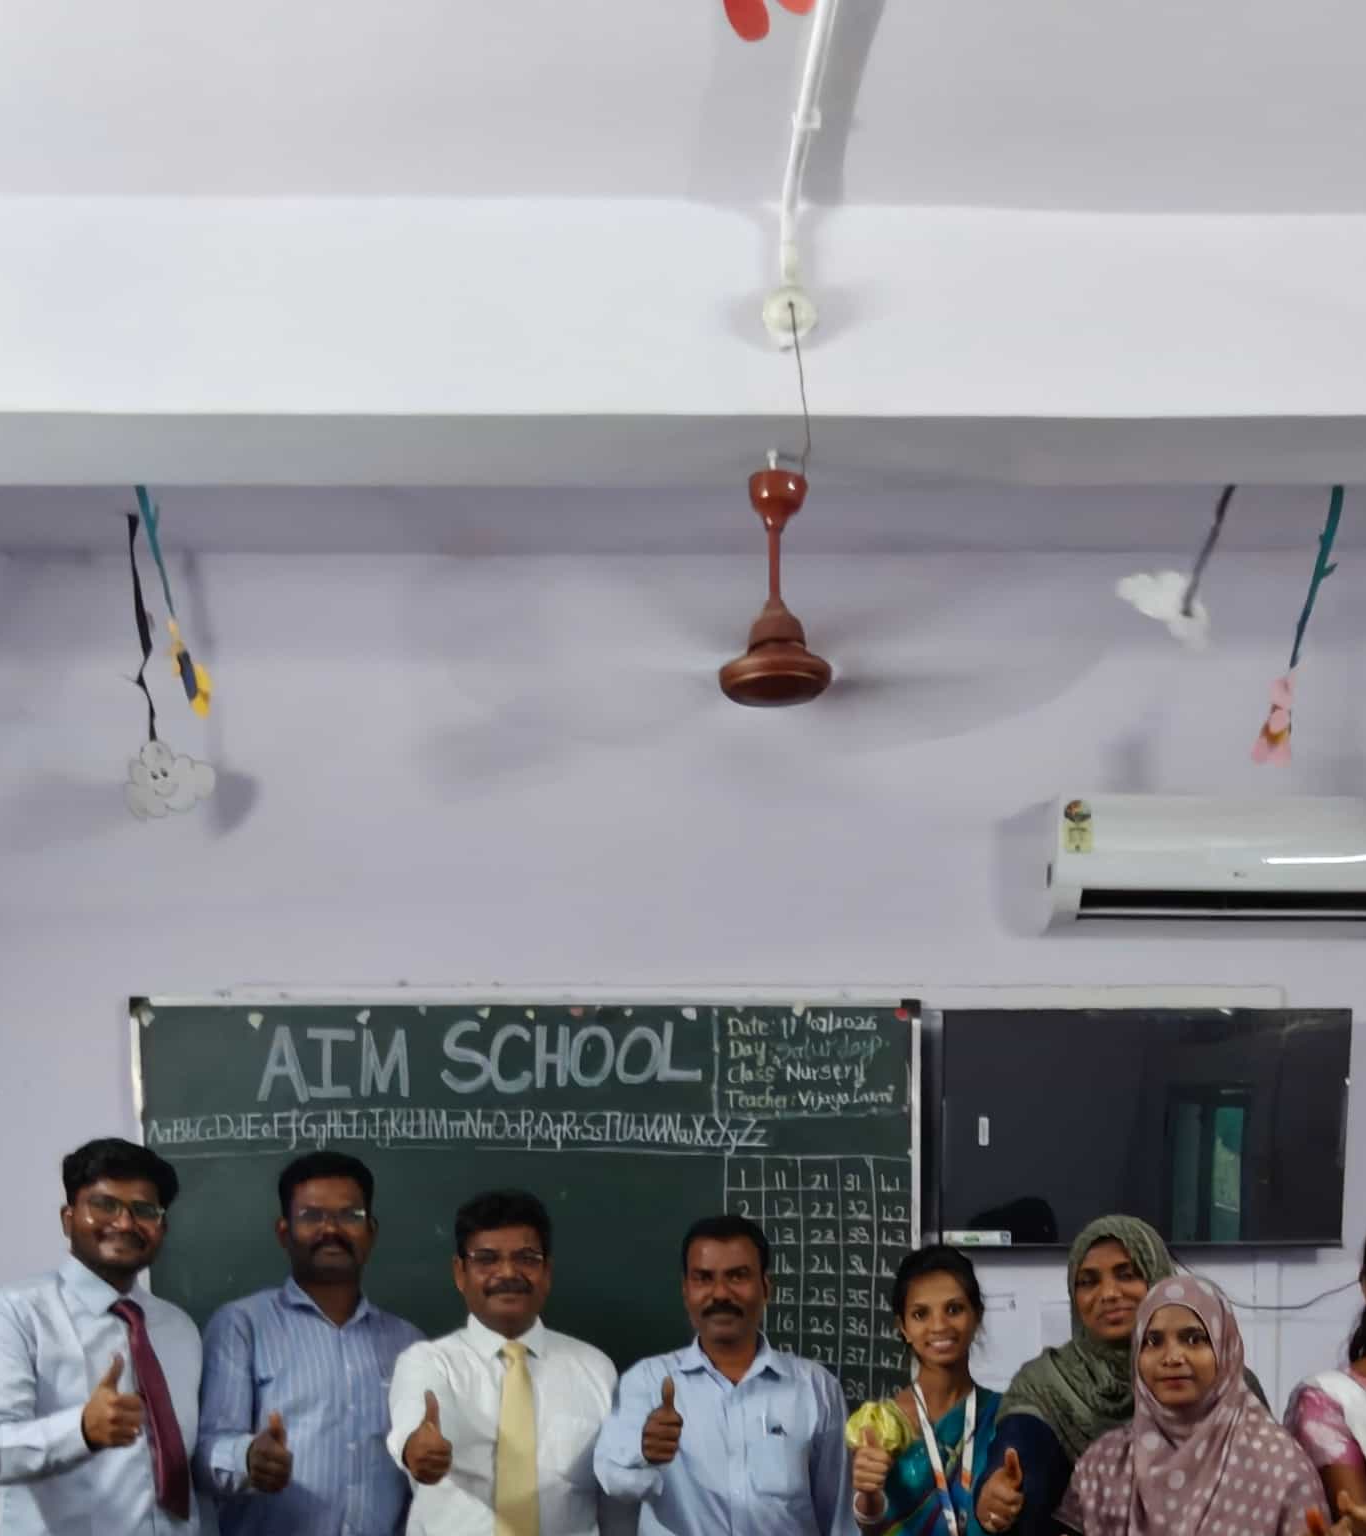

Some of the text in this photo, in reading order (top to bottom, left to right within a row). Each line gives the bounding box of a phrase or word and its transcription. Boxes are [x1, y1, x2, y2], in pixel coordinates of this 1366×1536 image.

[257, 1019, 703, 1102] AIM SCHOOL
[786, 1057, 866, 1089] Nursery
[740, 1168, 901, 1193] 1 11 21 31 41
[737, 1198, 906, 1222] 2 12 22 32 42
[774, 1225, 906, 1246] 13 23 33 43
[810, 1254, 835, 1275] 24
[775, 1286, 795, 1305] 15
[809, 1286, 836, 1306] 25
[846, 1288, 871, 1309] 35
[777, 1311, 795, 1333] 16
[809, 1318, 835, 1335] 26
[845, 1315, 868, 1337] 36
[844, 1345, 866, 1365] 37
[880, 1348, 905, 1370] 47
